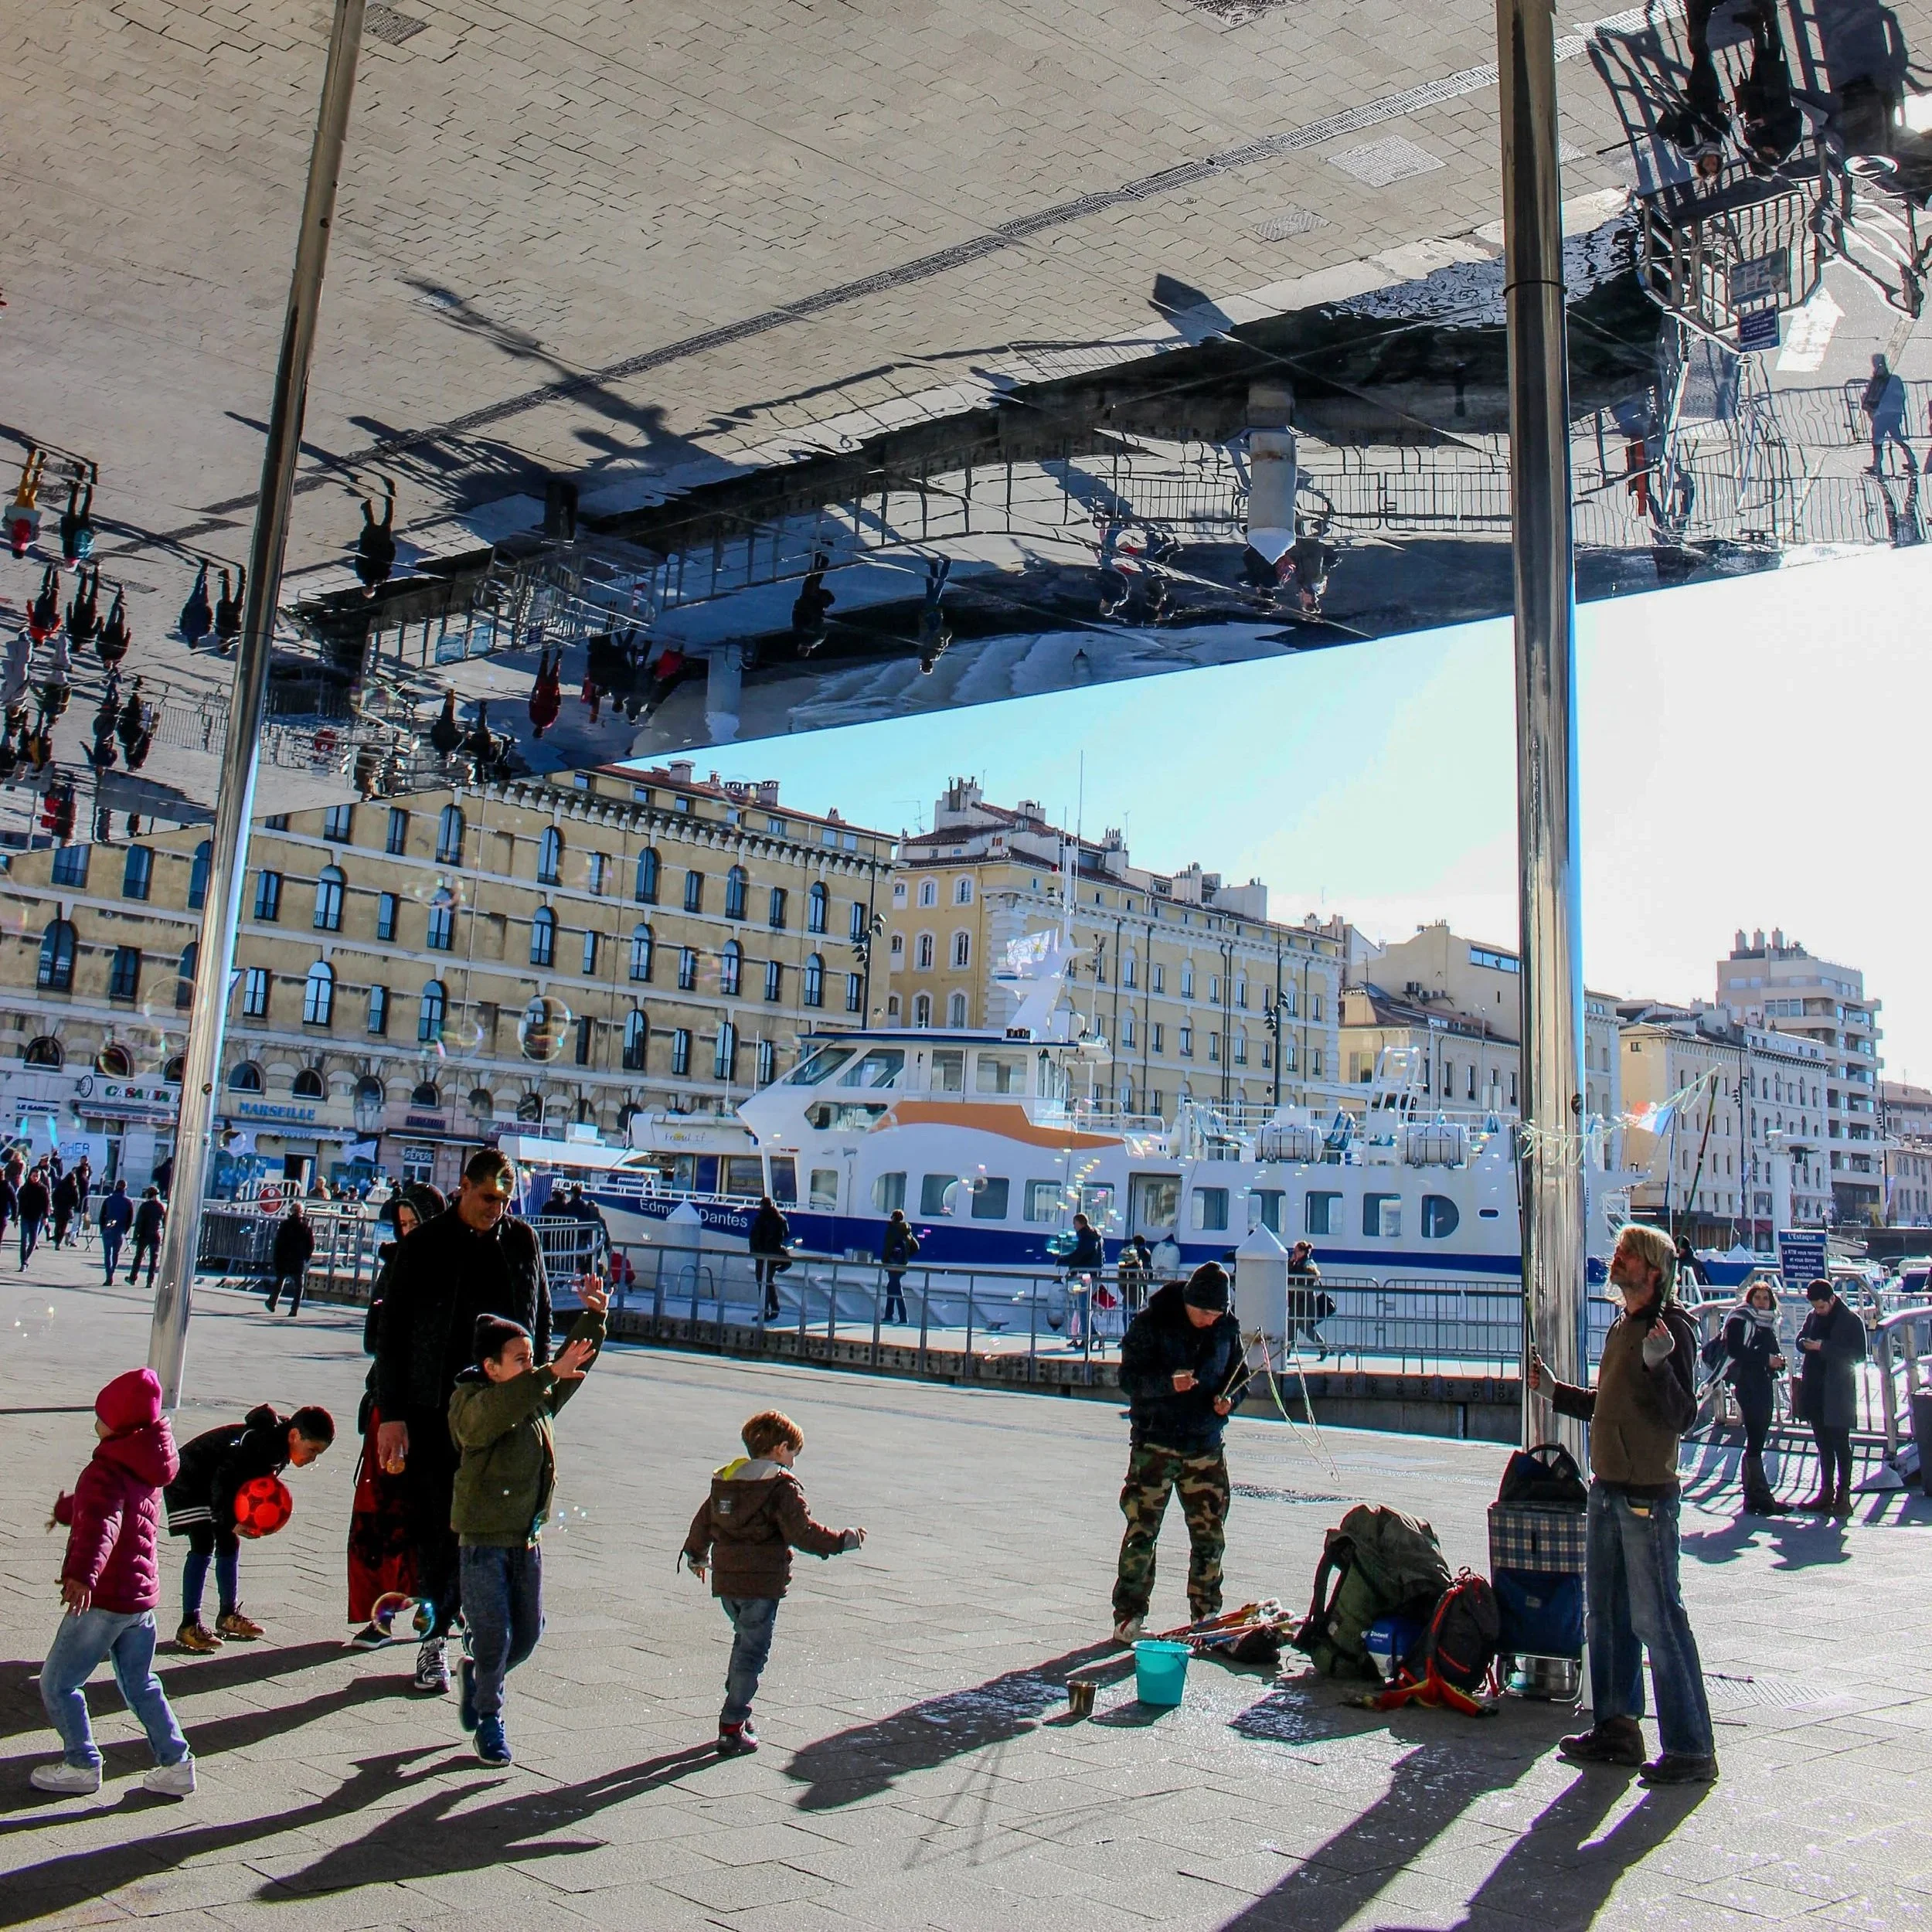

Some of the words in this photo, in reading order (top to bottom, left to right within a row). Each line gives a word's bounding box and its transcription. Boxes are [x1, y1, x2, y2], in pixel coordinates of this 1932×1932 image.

[105, 1085, 143, 1099] CASA
[240, 1102, 315, 1121] MARSEILLE
[699, 1209, 748, 1228] Dantes
